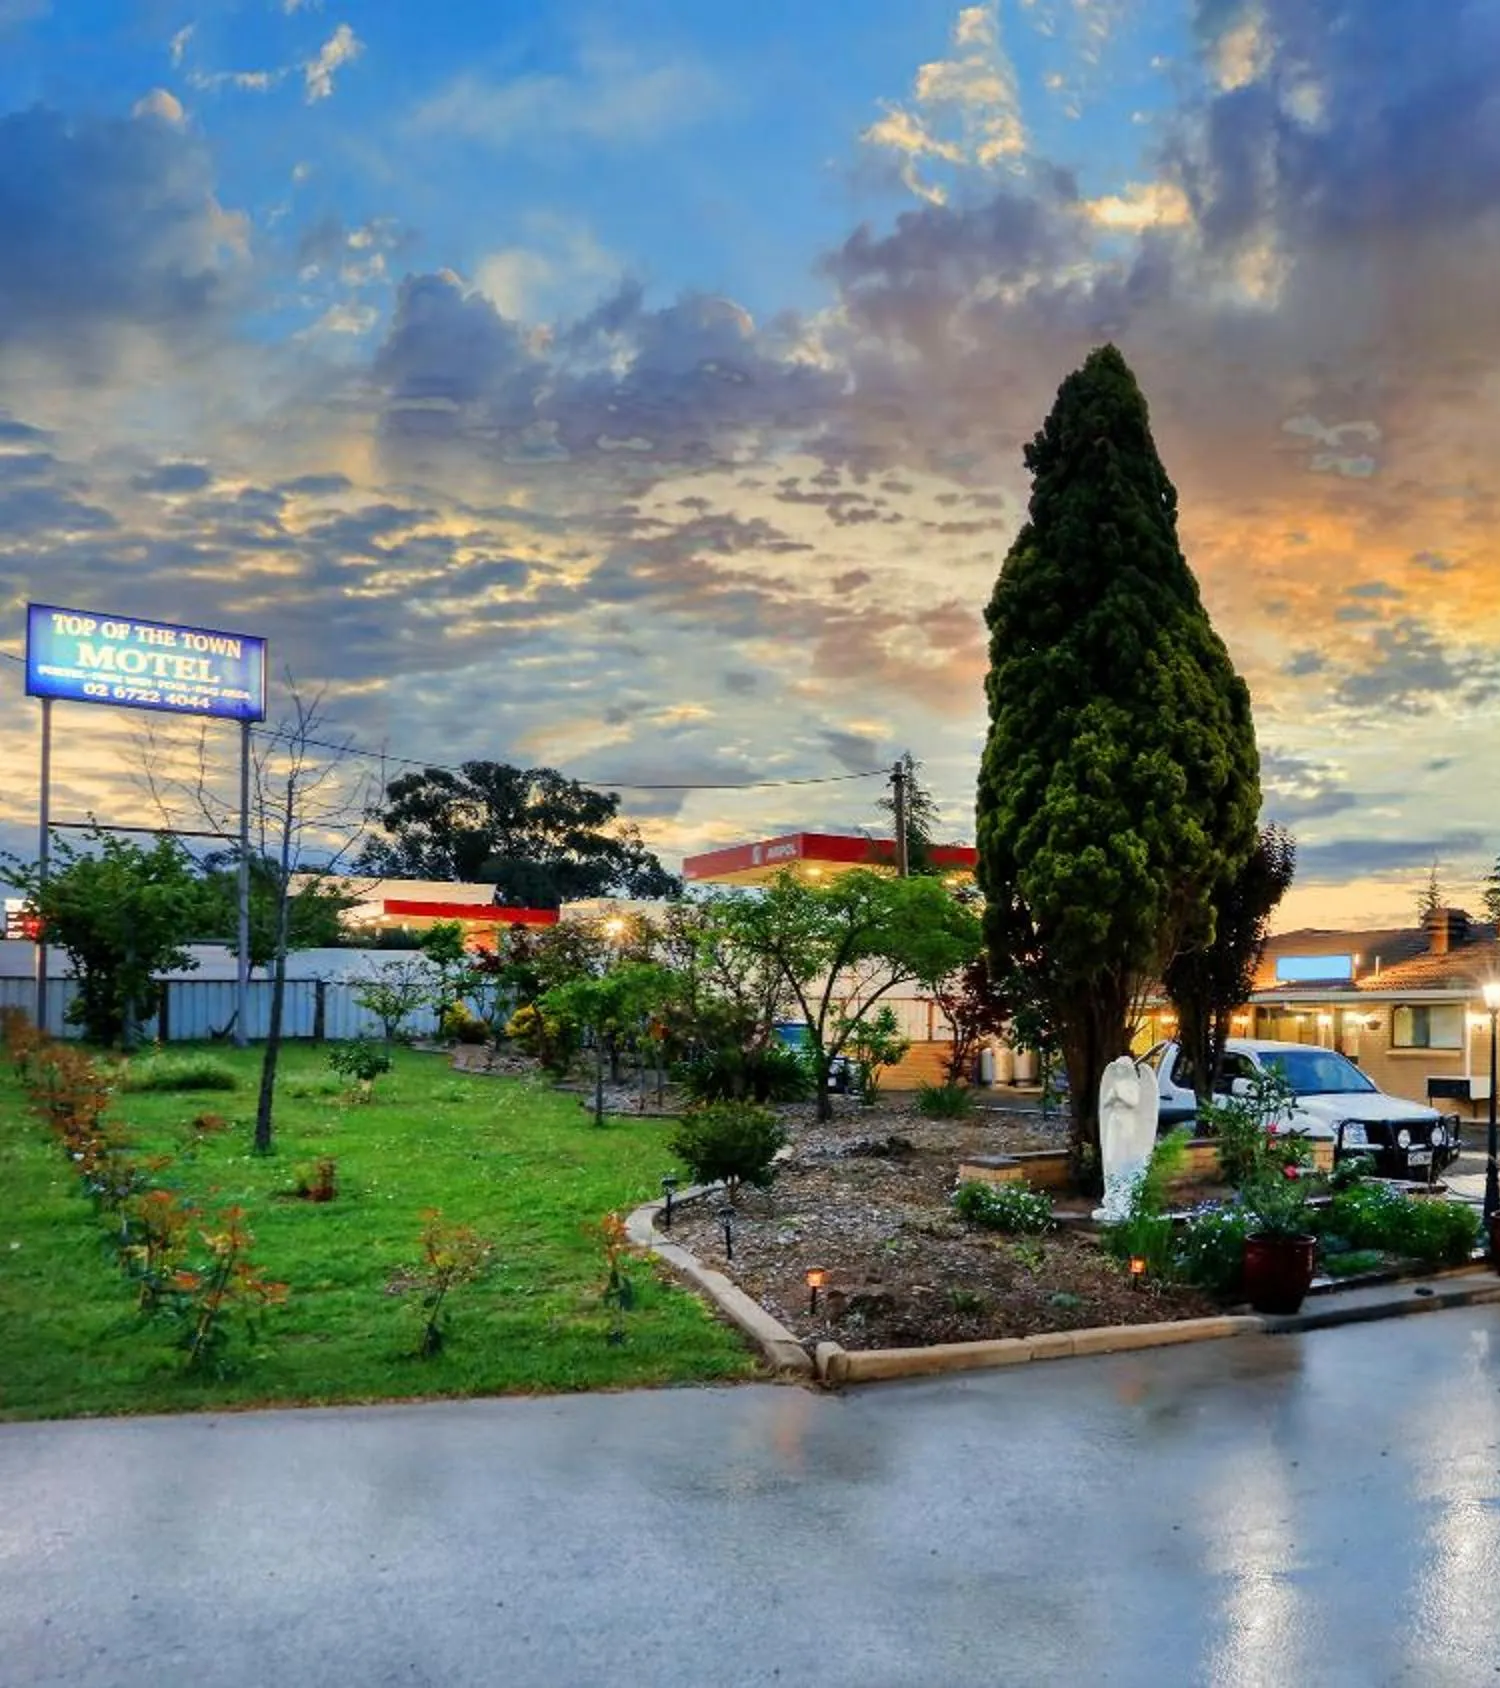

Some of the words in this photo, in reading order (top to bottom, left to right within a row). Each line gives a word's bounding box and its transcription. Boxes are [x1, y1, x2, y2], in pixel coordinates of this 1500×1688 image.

[51, 613, 97, 637] TOP
[100, 621, 131, 640] OF
[135, 625, 177, 647] THE
[181, 633, 242, 659] TOWN
[76, 642, 221, 684] MOTEL
[83, 682, 108, 697] 02
[113, 687, 161, 703] 6722
[165, 692, 211, 708] 4044
